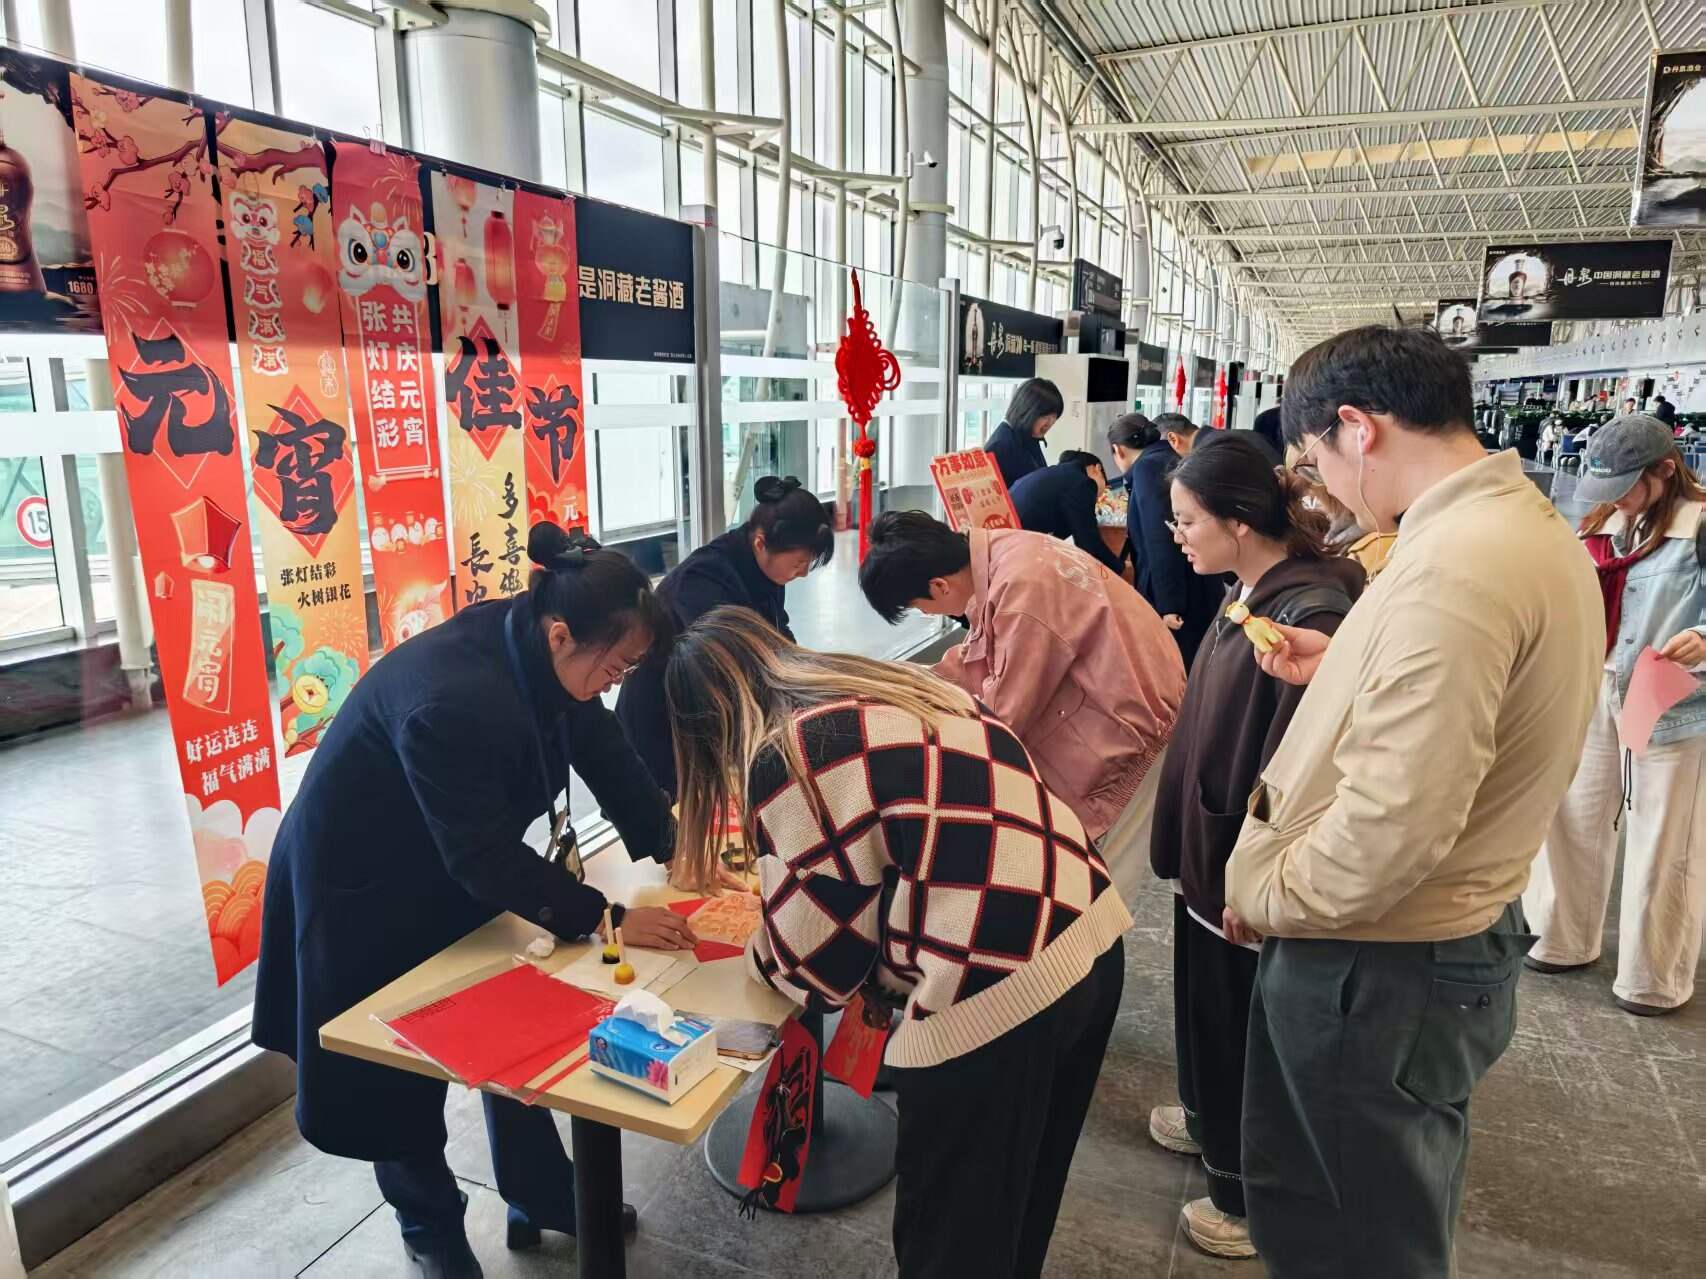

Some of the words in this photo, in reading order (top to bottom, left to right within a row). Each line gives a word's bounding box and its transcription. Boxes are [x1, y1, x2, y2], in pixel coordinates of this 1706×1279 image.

[68, 280, 94, 295] 1680
[579, 265, 684, 310] 是洞藏老酱酒
[118, 333, 235, 456] 元
[360, 301, 400, 448] 张灯结彩
[391, 304, 425, 446] 共庆元宵
[445, 335, 523, 432] 佳
[526, 385, 580, 484] 节
[251, 403, 347, 535] 宵
[935, 449, 989, 477] 万事如意
[28, 510, 50, 535] 15
[280, 561, 337, 587] 张灯结彩
[297, 583, 352, 610] 火树银花
[185, 719, 259, 765] 好运连连
[201, 746, 272, 797] 福气满满
